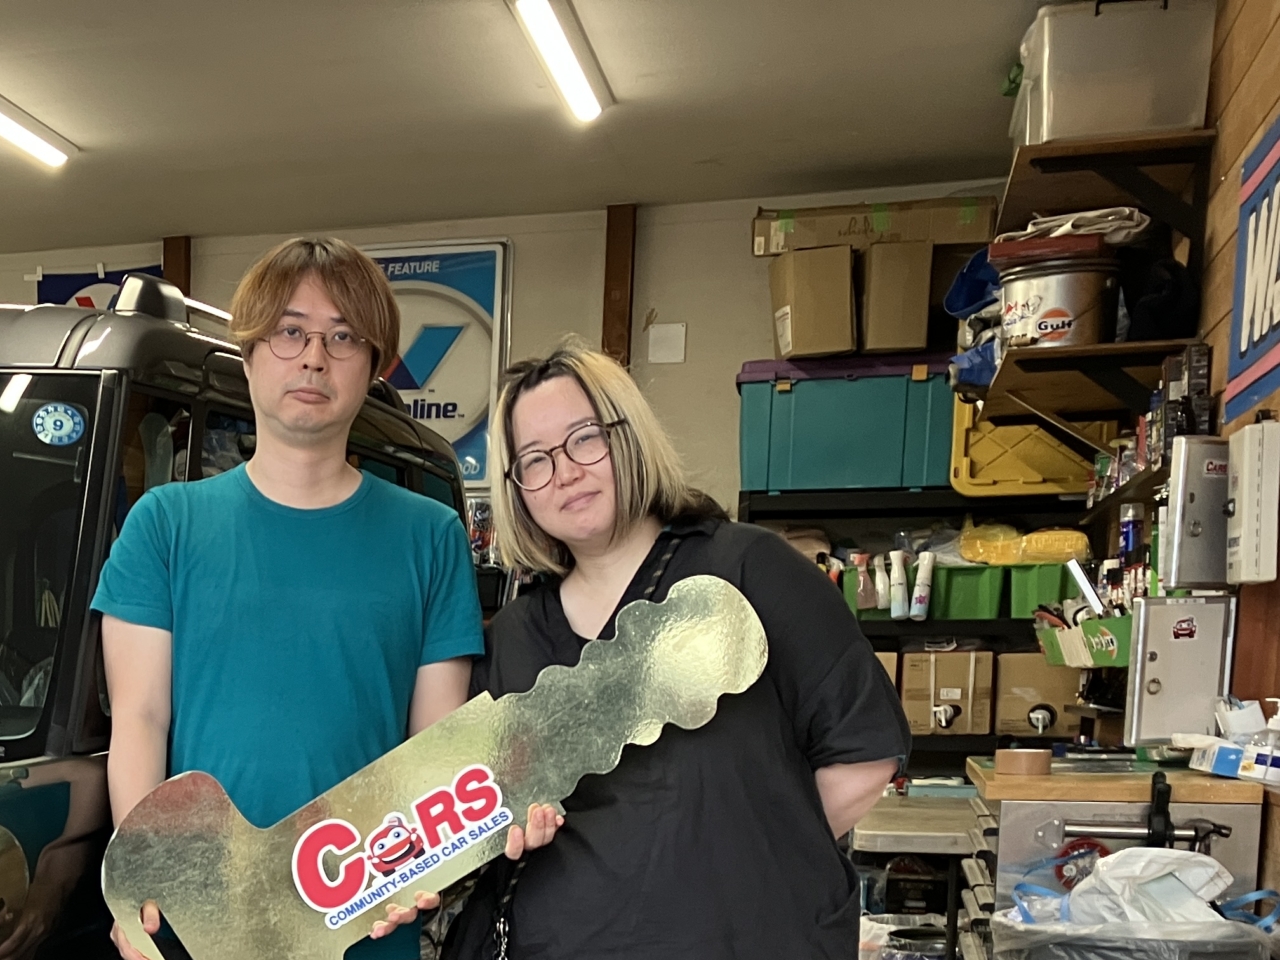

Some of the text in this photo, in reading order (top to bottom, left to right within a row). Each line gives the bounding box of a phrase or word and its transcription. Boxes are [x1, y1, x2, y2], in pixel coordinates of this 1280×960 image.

[387, 260, 440, 275] FEATURE
[1038, 320, 1073, 331] Gulf
[53, 419, 64, 431] 9
[297, 768, 498, 909] CRS
[328, 811, 510, 927] COMMUNITY-BASED CAR SALES
